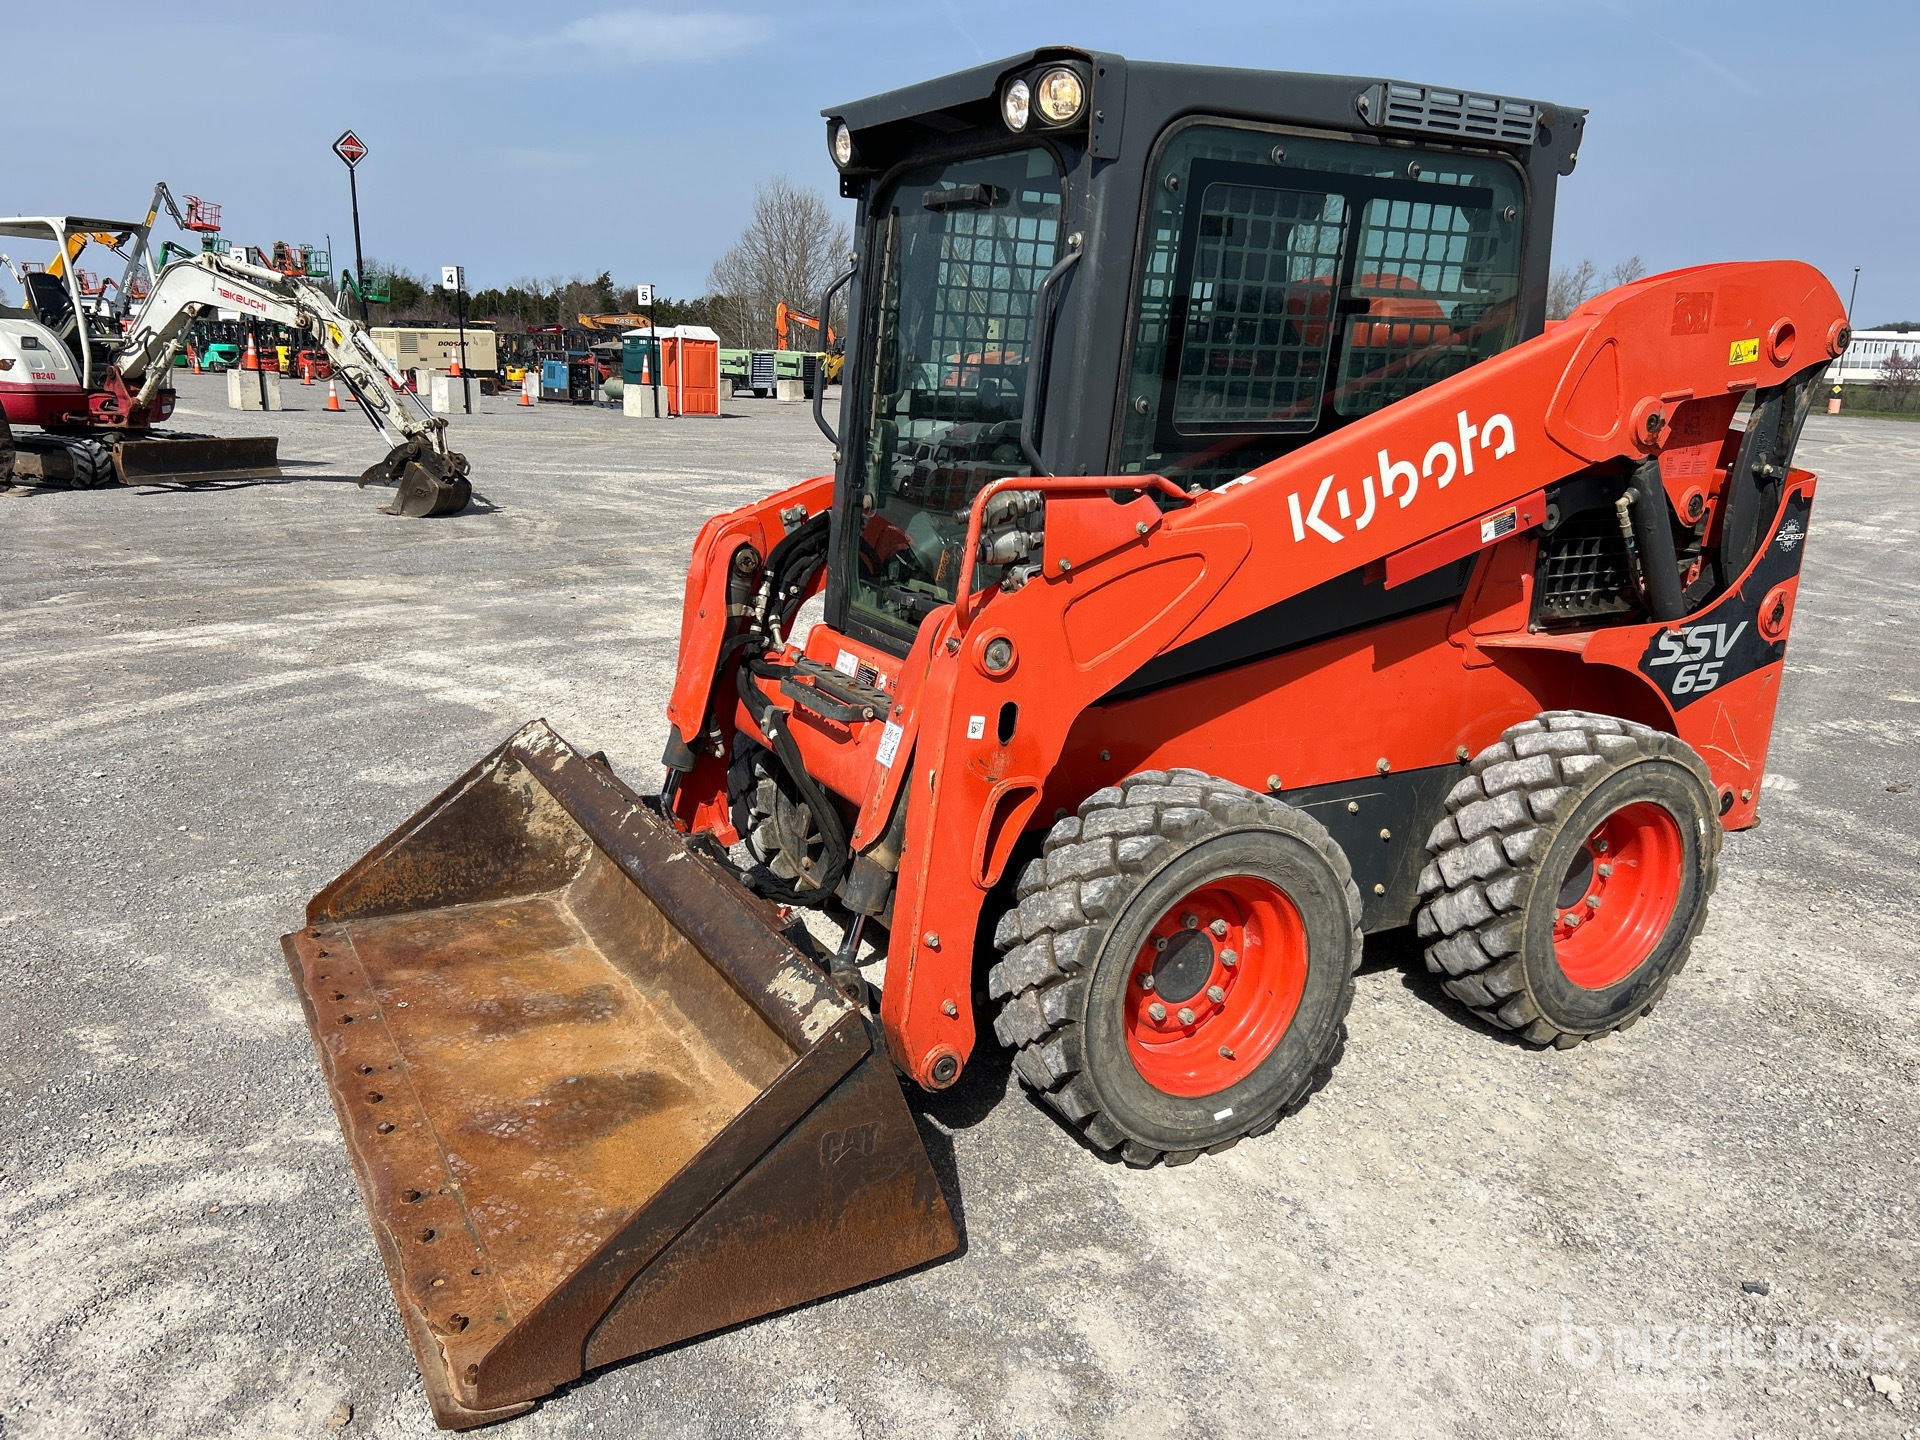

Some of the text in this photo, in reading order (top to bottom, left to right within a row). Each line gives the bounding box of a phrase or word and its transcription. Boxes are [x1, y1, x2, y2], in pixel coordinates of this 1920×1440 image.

[446, 273, 454, 285] 4
[641, 291, 648, 301] 5
[613, 317, 634, 325] CASE
[31, 372, 56, 381] TB240
[1287, 410, 1516, 544] Kubota
[1649, 620, 1749, 667] SSV
[1671, 661, 1724, 695] 65
[820, 1121, 880, 1168] CAT
